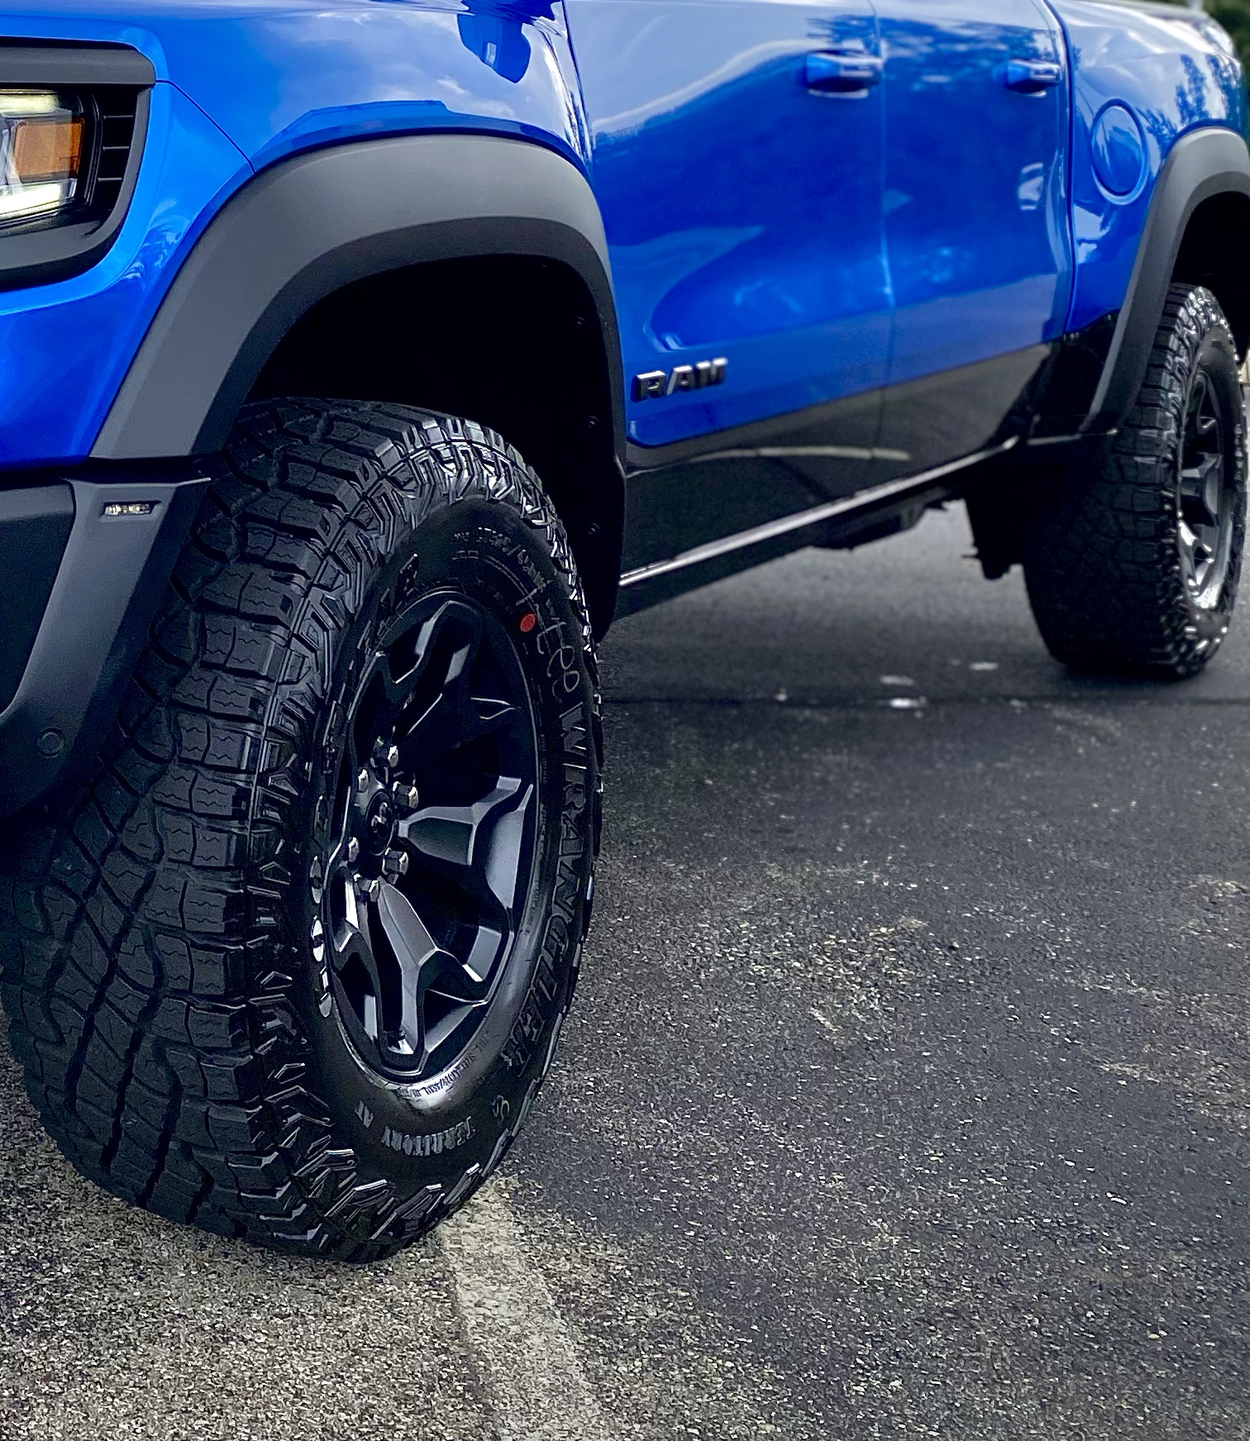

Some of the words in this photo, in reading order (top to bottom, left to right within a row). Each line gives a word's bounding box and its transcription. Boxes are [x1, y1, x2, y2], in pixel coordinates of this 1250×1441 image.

[631, 357, 728, 403] RAM
[500, 701, 588, 1078] WRANGLER
[380, 1115, 477, 1157] TERRITORY
